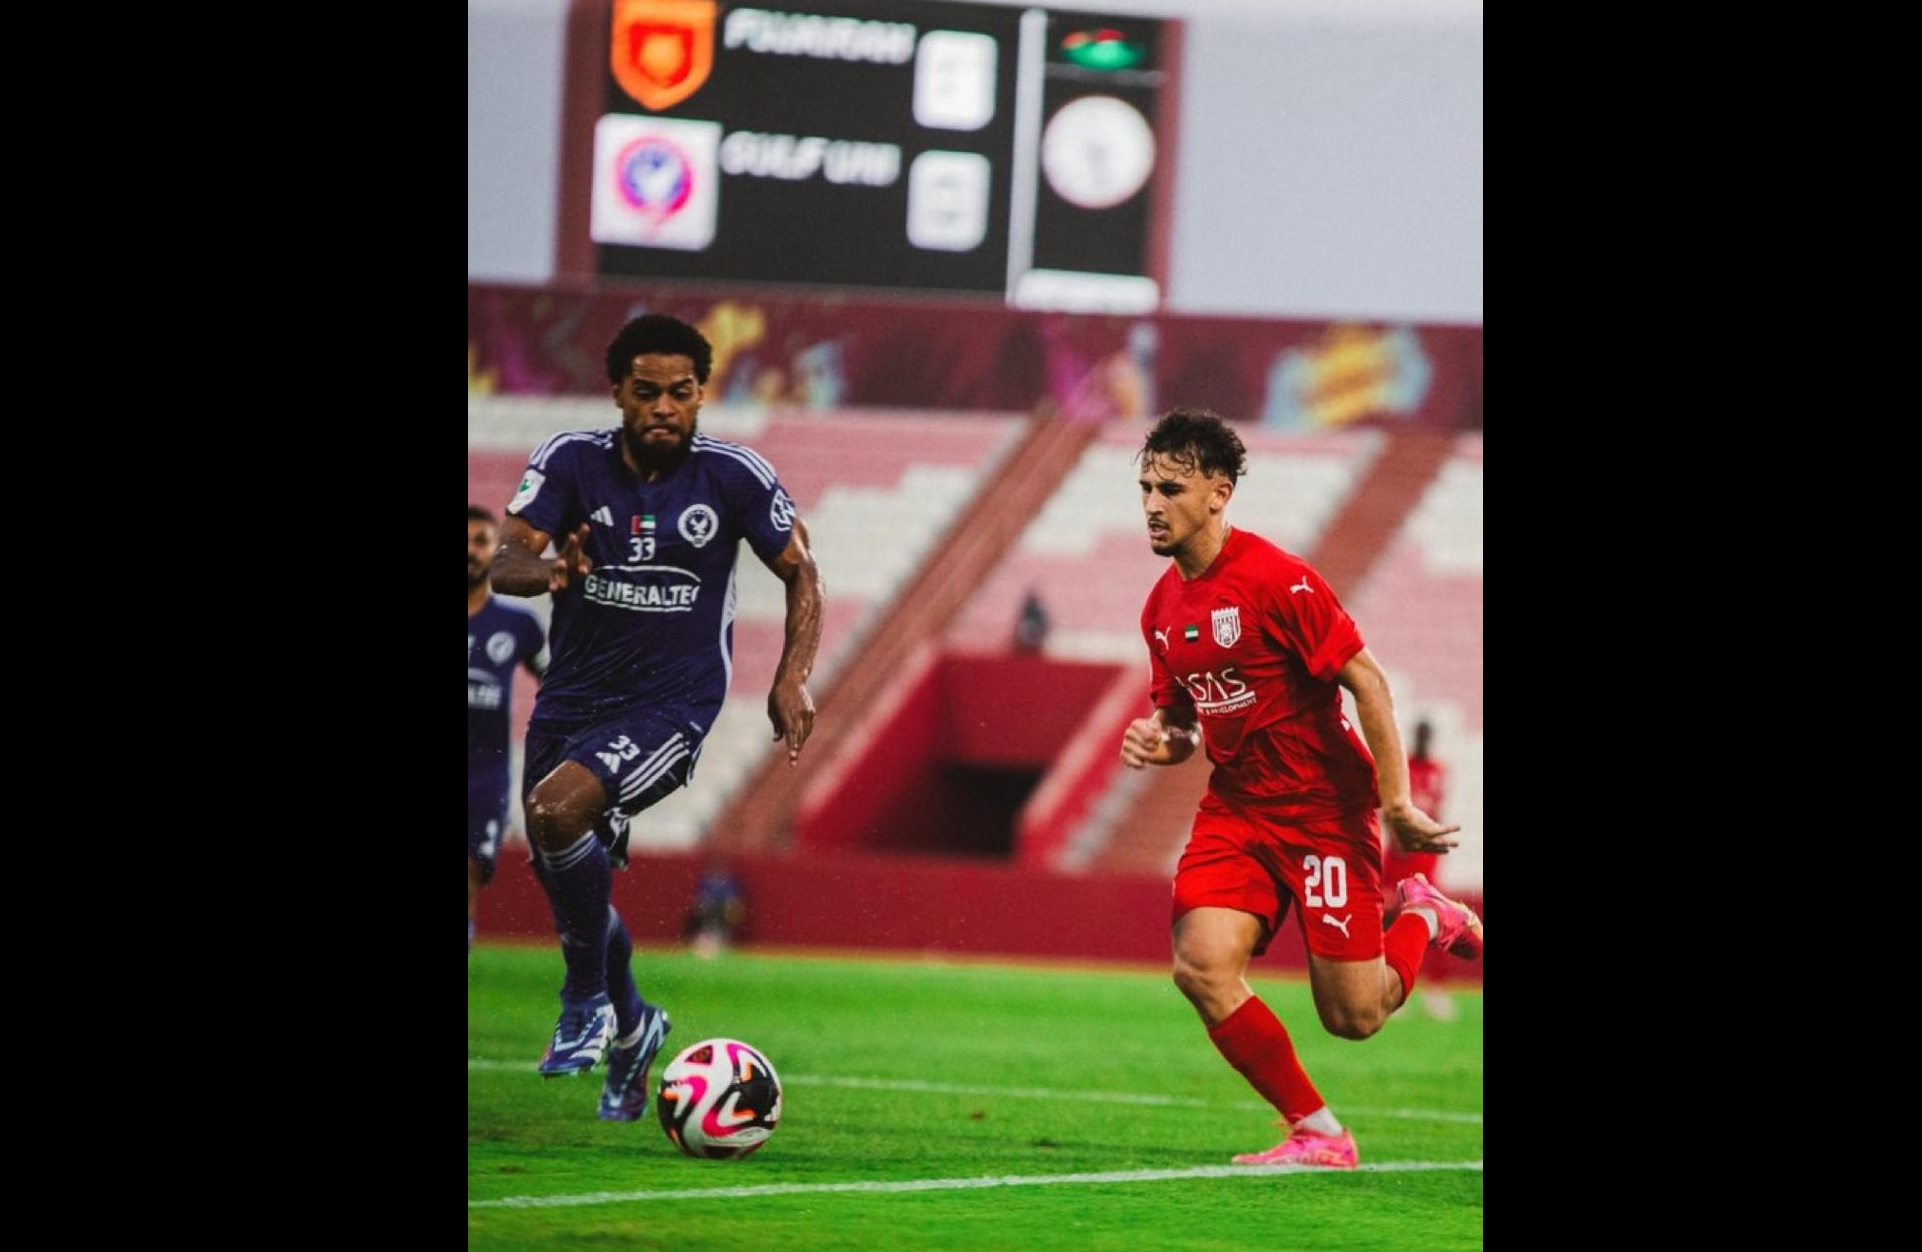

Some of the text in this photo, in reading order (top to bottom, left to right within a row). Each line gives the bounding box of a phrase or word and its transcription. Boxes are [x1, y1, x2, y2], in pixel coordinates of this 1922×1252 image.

[628, 537, 655, 562] 33
[608, 735, 641, 761] 33
[1303, 854, 1348, 908] 20
